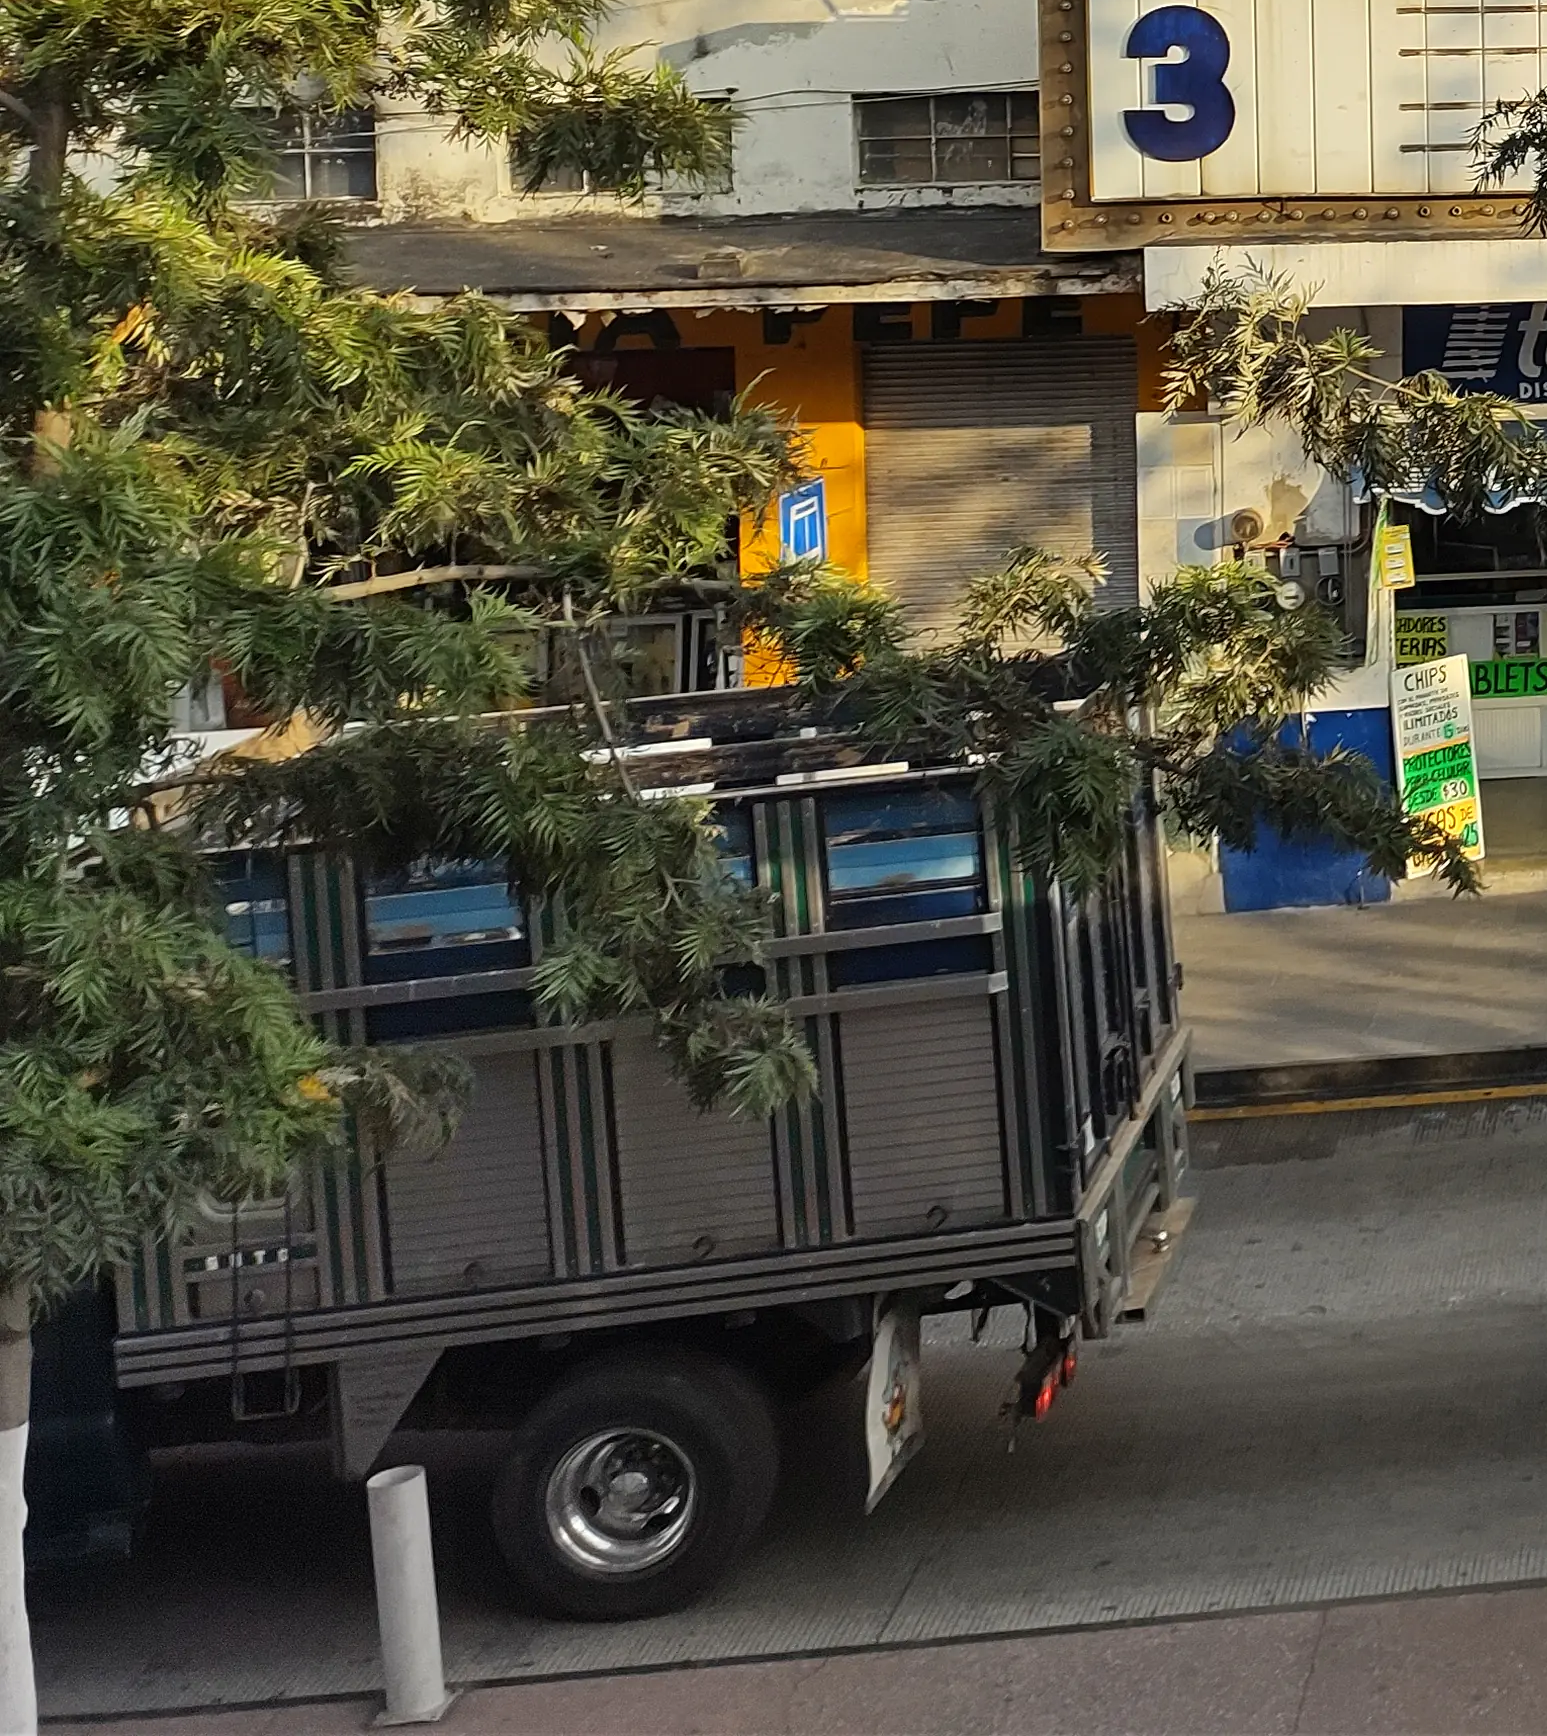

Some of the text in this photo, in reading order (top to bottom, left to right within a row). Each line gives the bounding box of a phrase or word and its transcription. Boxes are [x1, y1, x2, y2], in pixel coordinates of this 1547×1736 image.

[1124, 5, 1236, 162] 3
[1404, 665, 1446, 692] CHIPS
[1443, 780, 1468, 799] $30
[1460, 807, 1472, 820] DE
